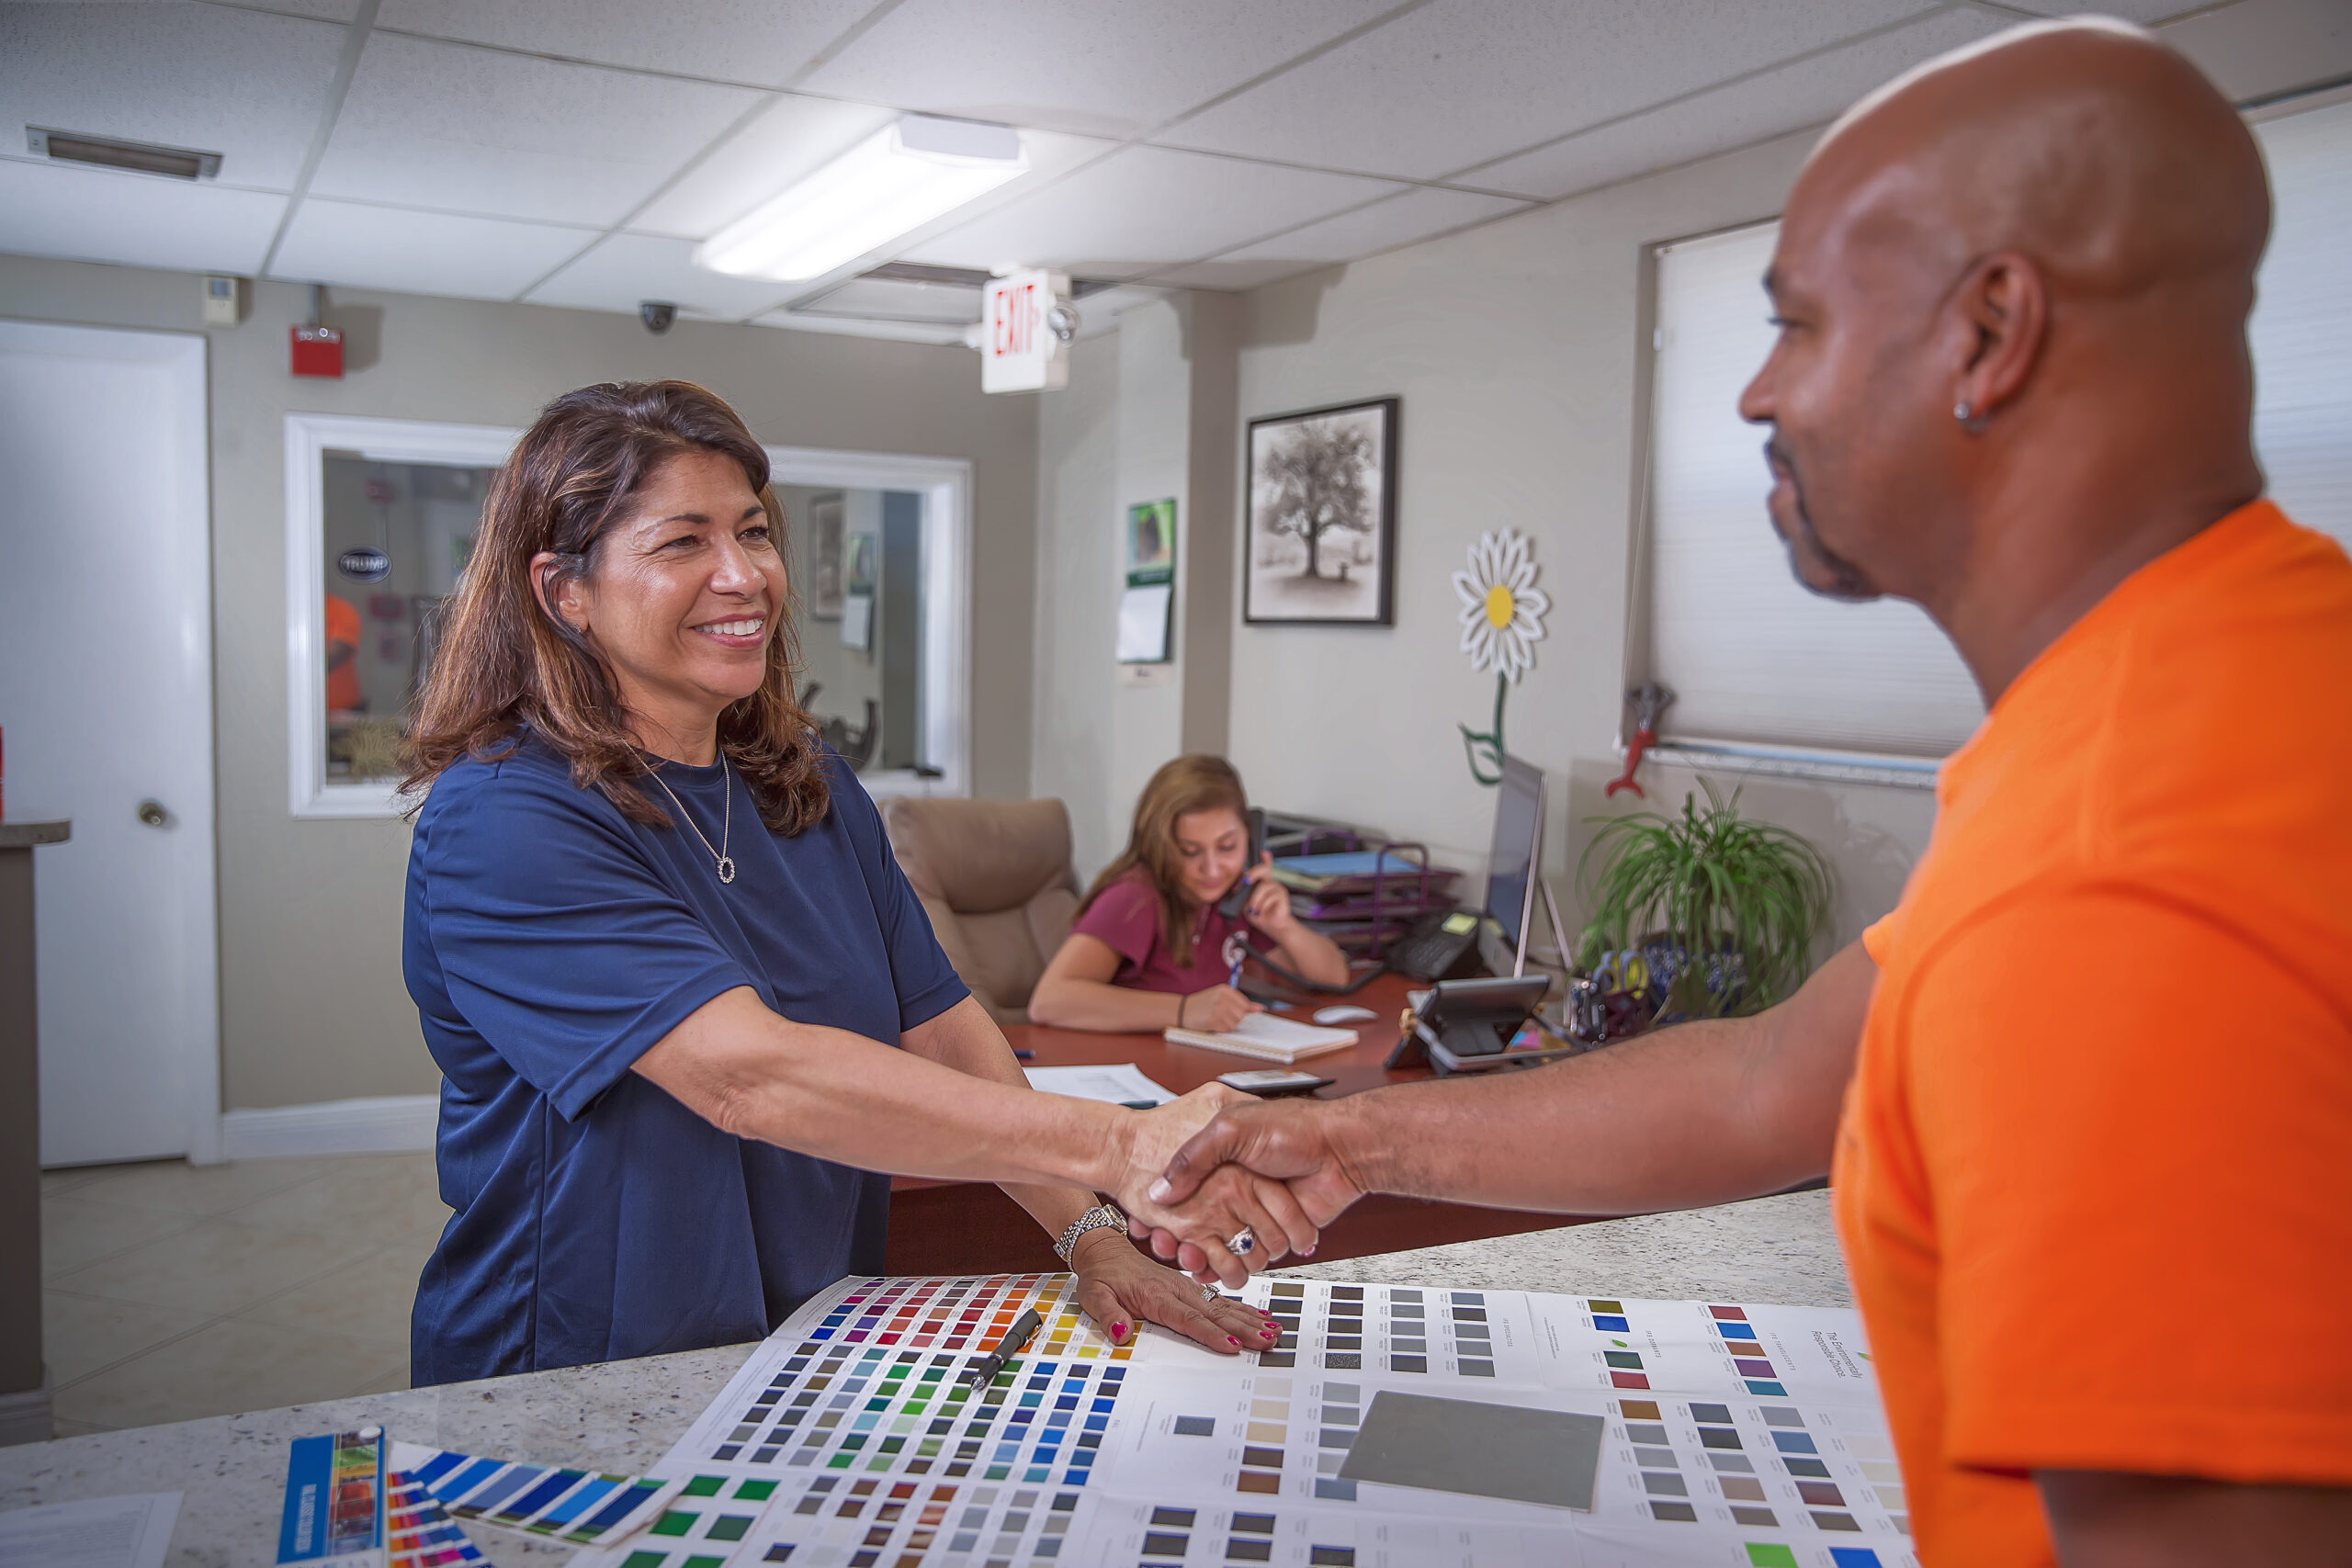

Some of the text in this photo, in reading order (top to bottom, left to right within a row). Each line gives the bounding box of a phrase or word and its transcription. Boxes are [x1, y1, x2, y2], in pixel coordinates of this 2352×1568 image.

[993, 284, 1035, 356] EXIT
[343, 556, 388, 572] TRUMP
[1811, 1330, 1836, 1359] Responsible
[1826, 1331, 1863, 1380] The Environmentally
